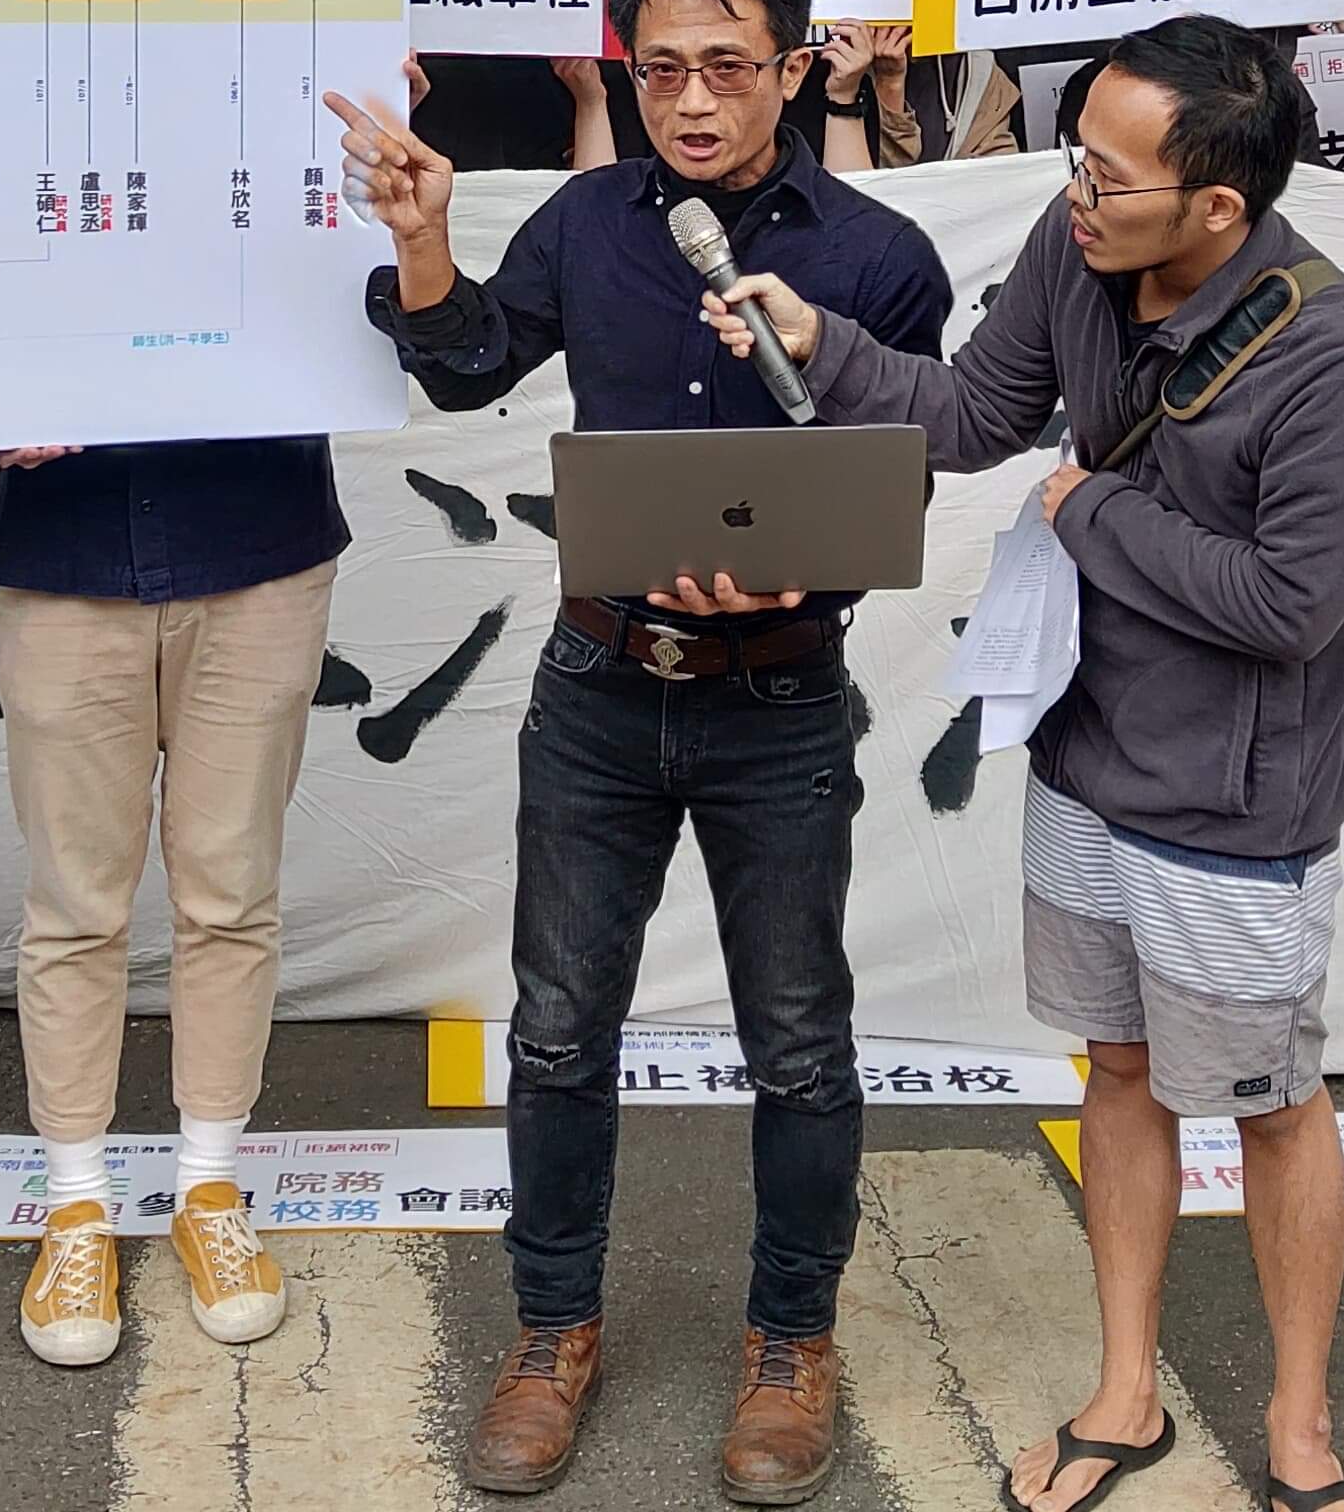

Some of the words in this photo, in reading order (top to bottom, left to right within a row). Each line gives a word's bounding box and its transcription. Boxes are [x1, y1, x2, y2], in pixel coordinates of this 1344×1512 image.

[36, 172, 56, 234] 王碩仁
[56, 195, 68, 232] 研究員
[80, 171, 100, 233] 盧思丞
[100, 194, 112, 231] 研究員
[126, 171, 147, 232] 陳家輝
[231, 168, 250, 229] 林欣名
[326, 192, 338, 229] 研究員
[275, 1170, 386, 1196] 院務
[394, 1187, 514, 1214] 會議
[268, 1198, 382, 1224] 校務
